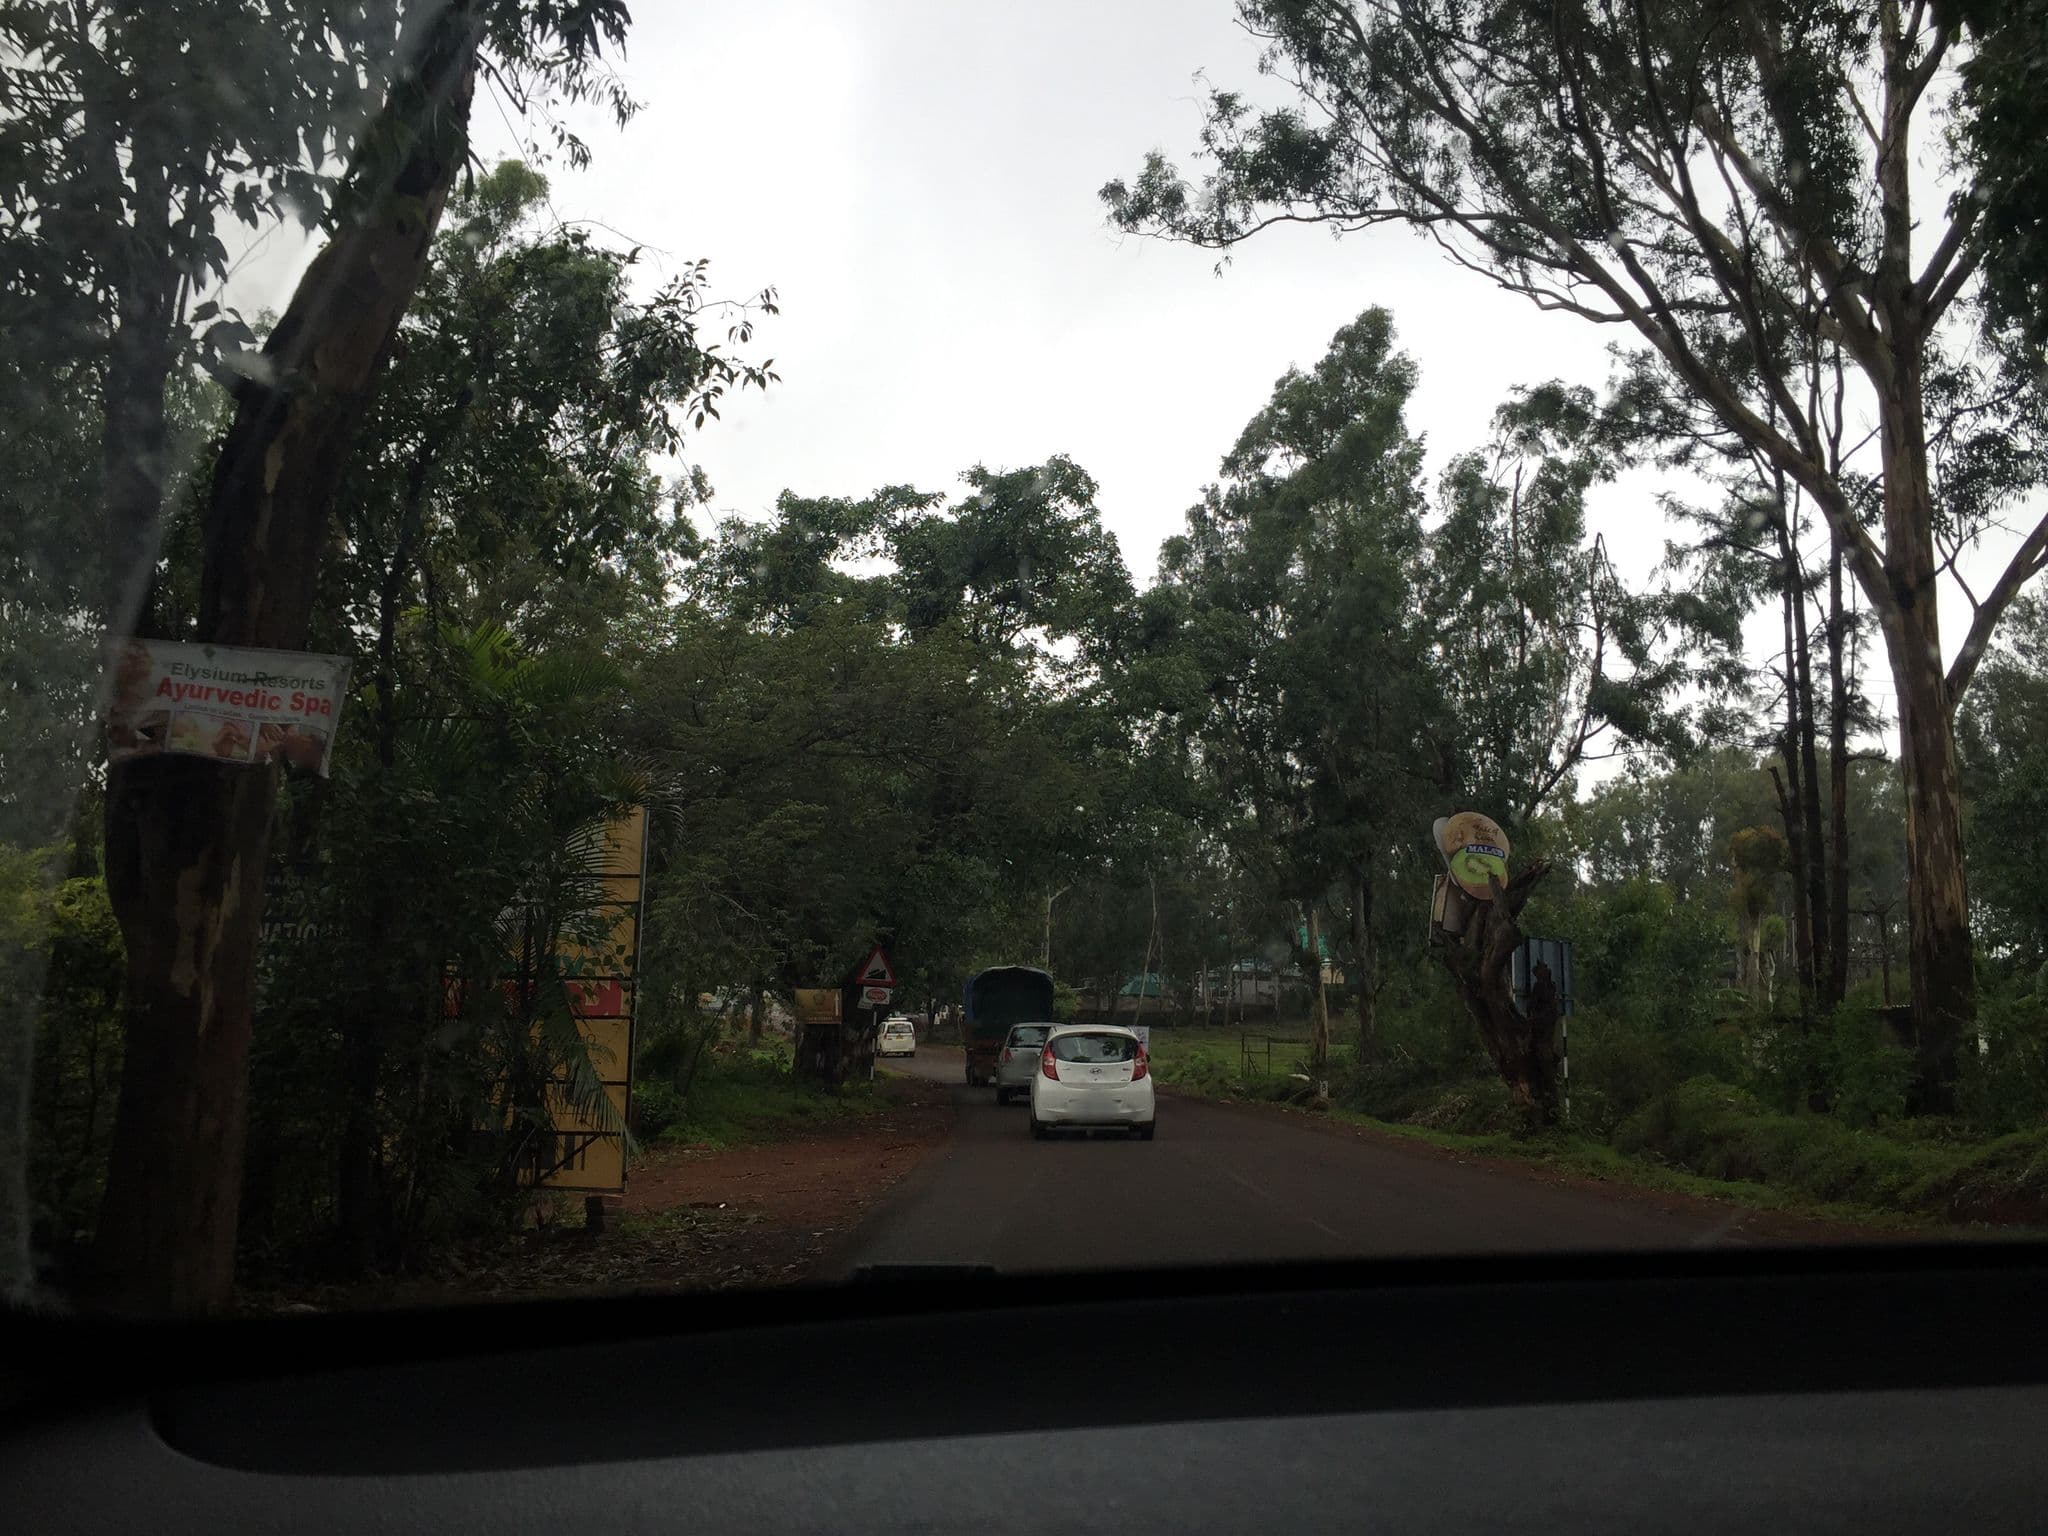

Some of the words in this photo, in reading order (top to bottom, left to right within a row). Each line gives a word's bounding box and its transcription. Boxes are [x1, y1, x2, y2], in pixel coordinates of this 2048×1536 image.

[171, 663, 249, 682] Elysium
[255, 671, 326, 690] Resorts
[157, 677, 281, 710] Ayurvedic
[290, 692, 331, 716] Spa
